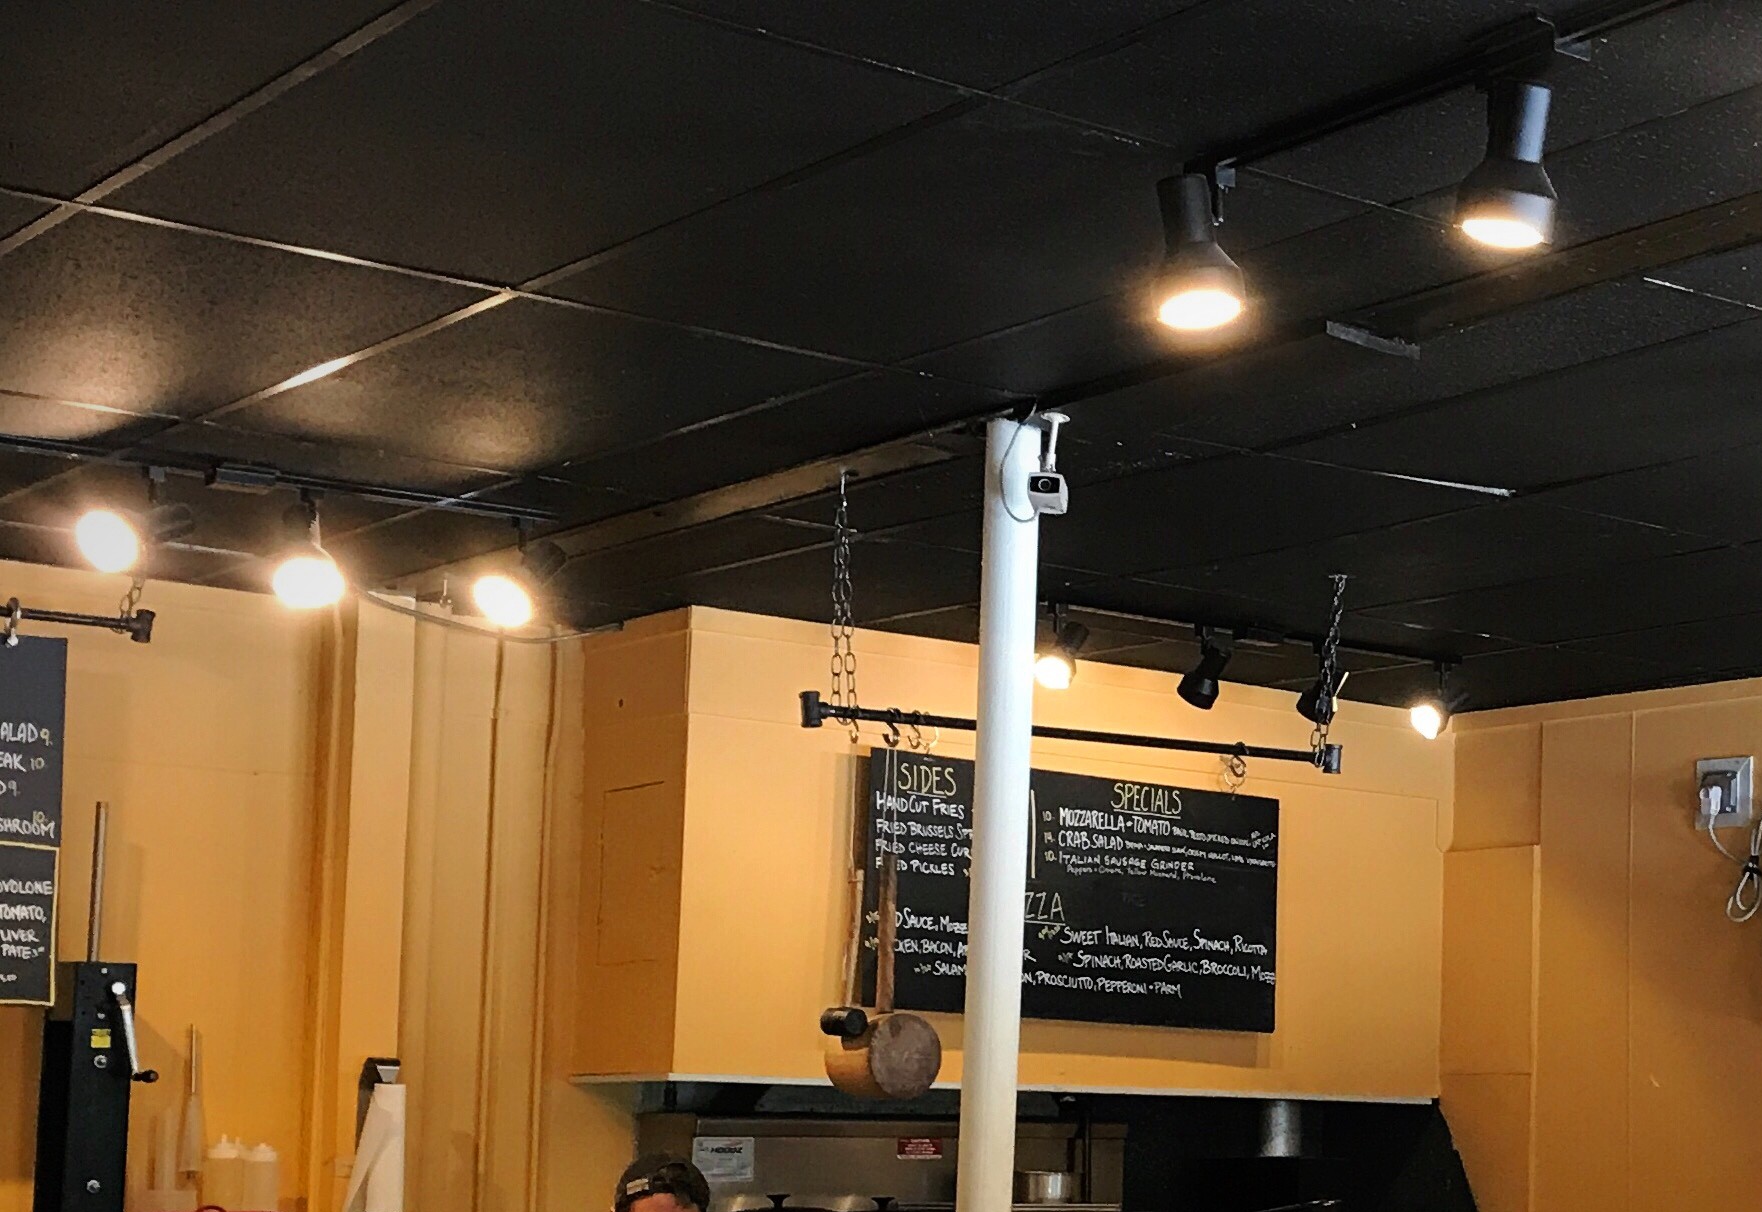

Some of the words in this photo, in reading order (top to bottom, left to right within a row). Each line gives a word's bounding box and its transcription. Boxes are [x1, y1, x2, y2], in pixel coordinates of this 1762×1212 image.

[898, 763, 957, 796] SIDES
[932, 799, 965, 819] FRIES
[1111, 783, 1182, 815] SPECIALS
[908, 822, 954, 840] BRUSSELS
[1059, 807, 1126, 832] MOZZARELLA
[1132, 815, 1171, 836] TOMATO
[908, 843, 948, 856] CHEESE
[1058, 830, 1090, 850] CRAB
[1091, 835, 1123, 850] SALAD
[910, 859, 955, 876] PICKLES
[1059, 851, 1100, 865] ITALIAN
[1104, 854, 1147, 868] SAUSAGE
[1151, 857, 1194, 871] GRINDER
[1060, 926, 1101, 945] SWEET
